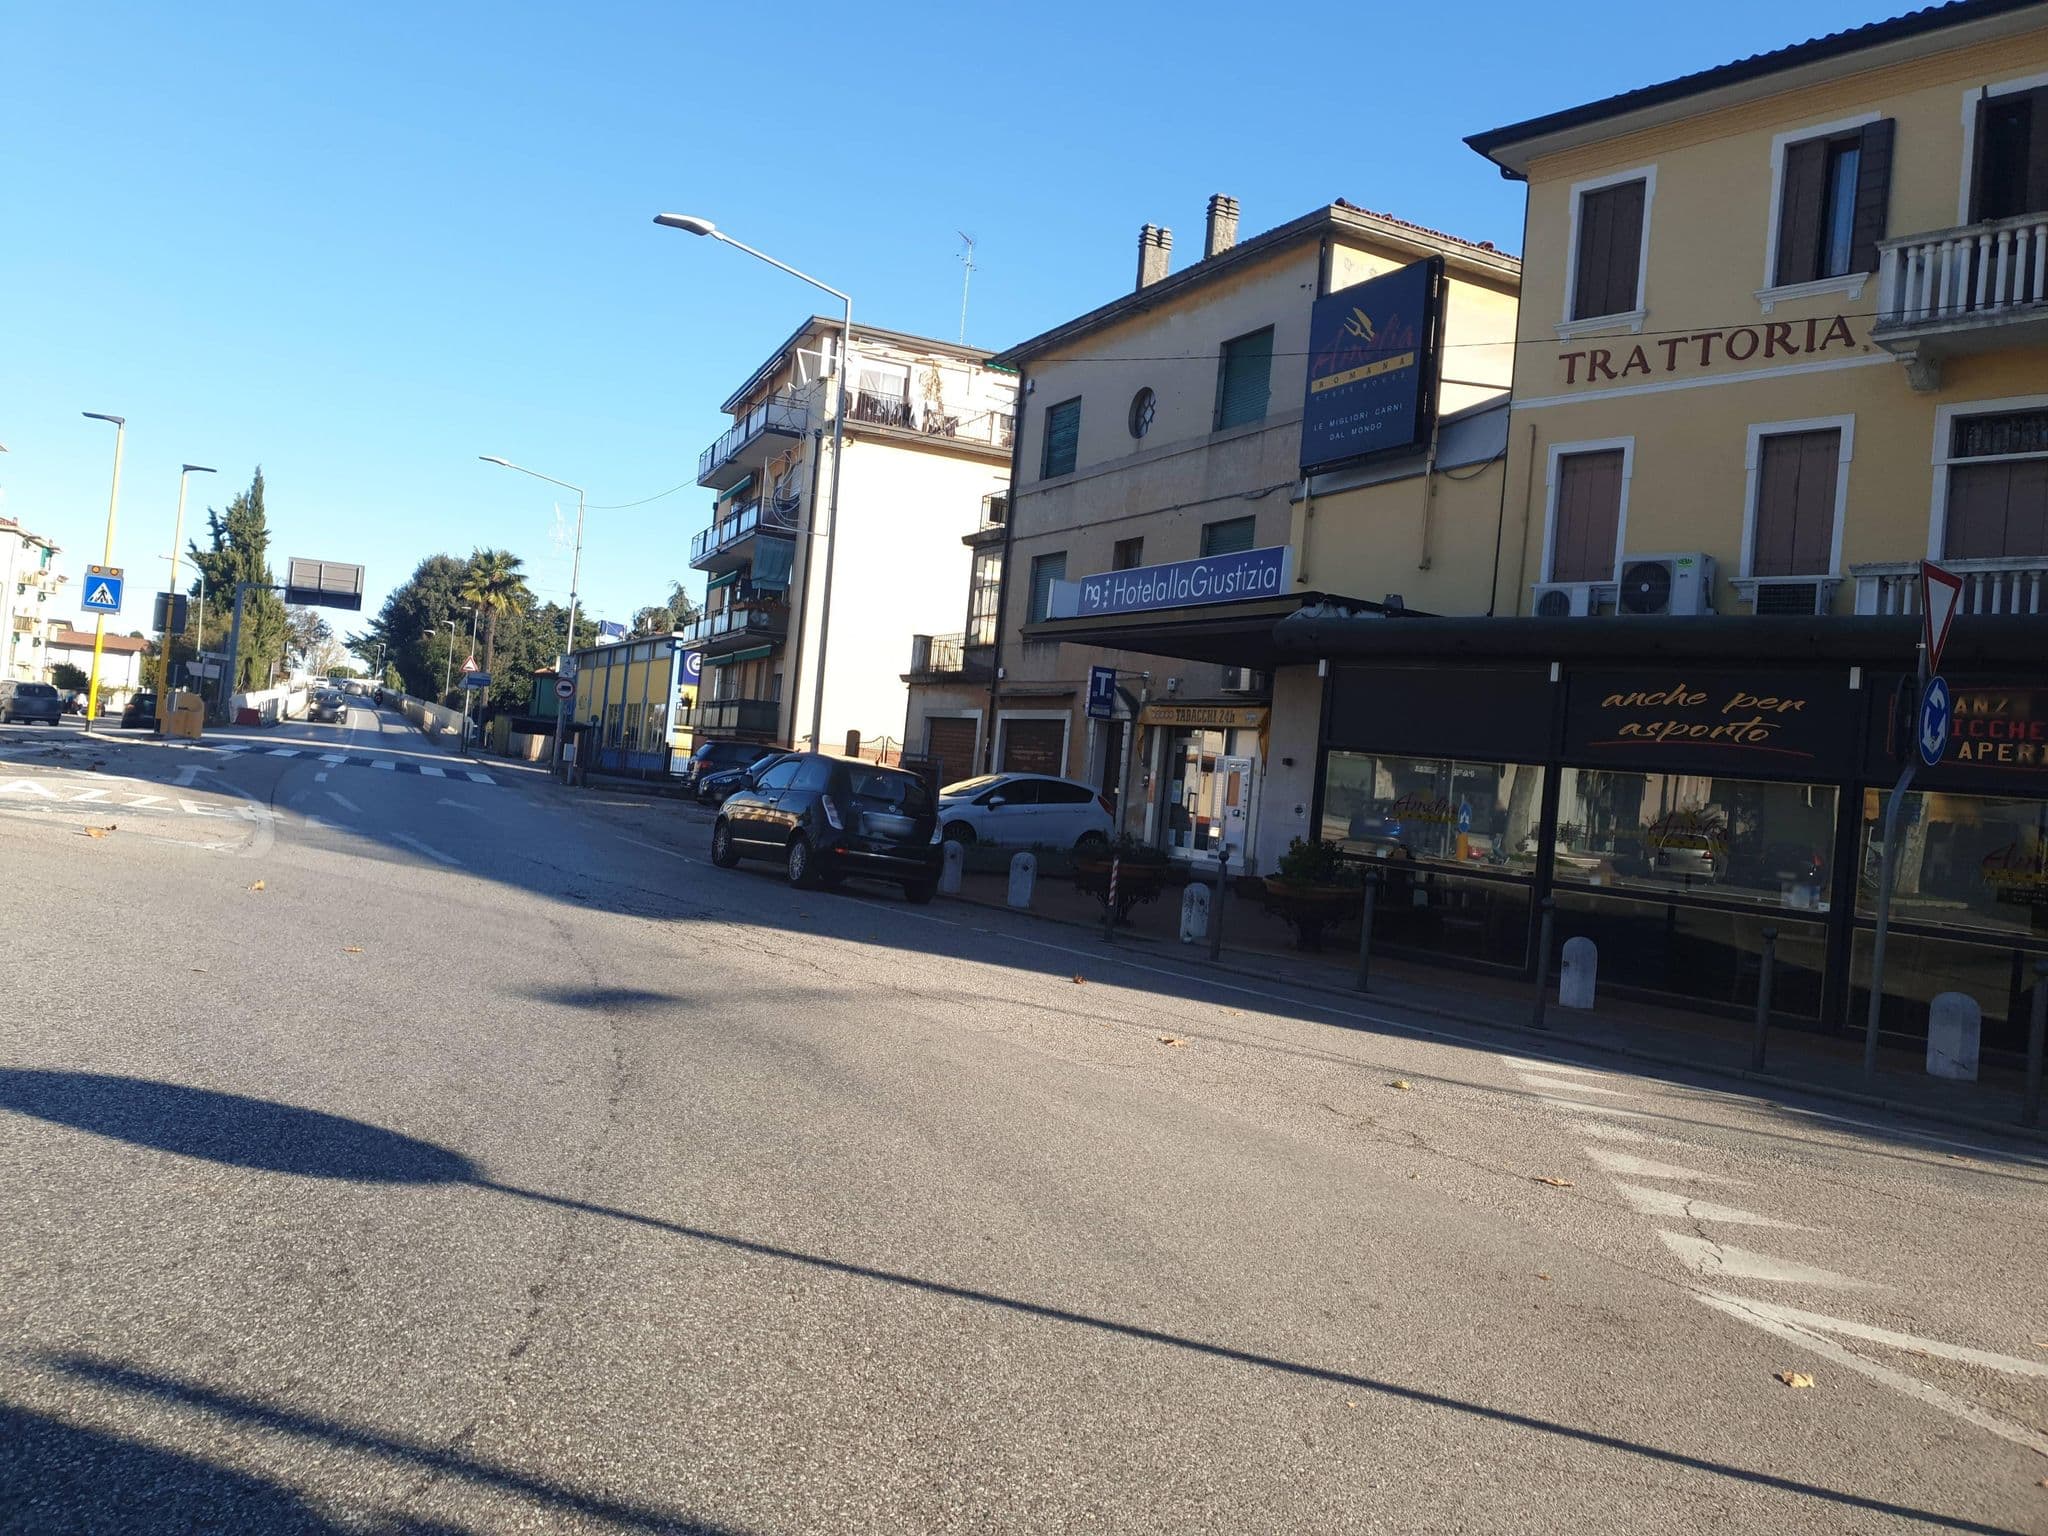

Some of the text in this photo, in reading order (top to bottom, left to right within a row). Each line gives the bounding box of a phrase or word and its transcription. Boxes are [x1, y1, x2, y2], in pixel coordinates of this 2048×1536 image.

[1558, 314, 1856, 384] TRATTORIA
[1319, 357, 1406, 388] ROMANA
[1329, 410, 1368, 427] MIGLIORI
[1375, 403, 1403, 416] CARNI
[1329, 422, 1382, 441] DAL MONDO
[1096, 671, 1113, 696] T
[1601, 682, 1807, 714] anche per
[1175, 708, 1218, 723] TABACCHI
[1618, 716, 1781, 743] asporto
